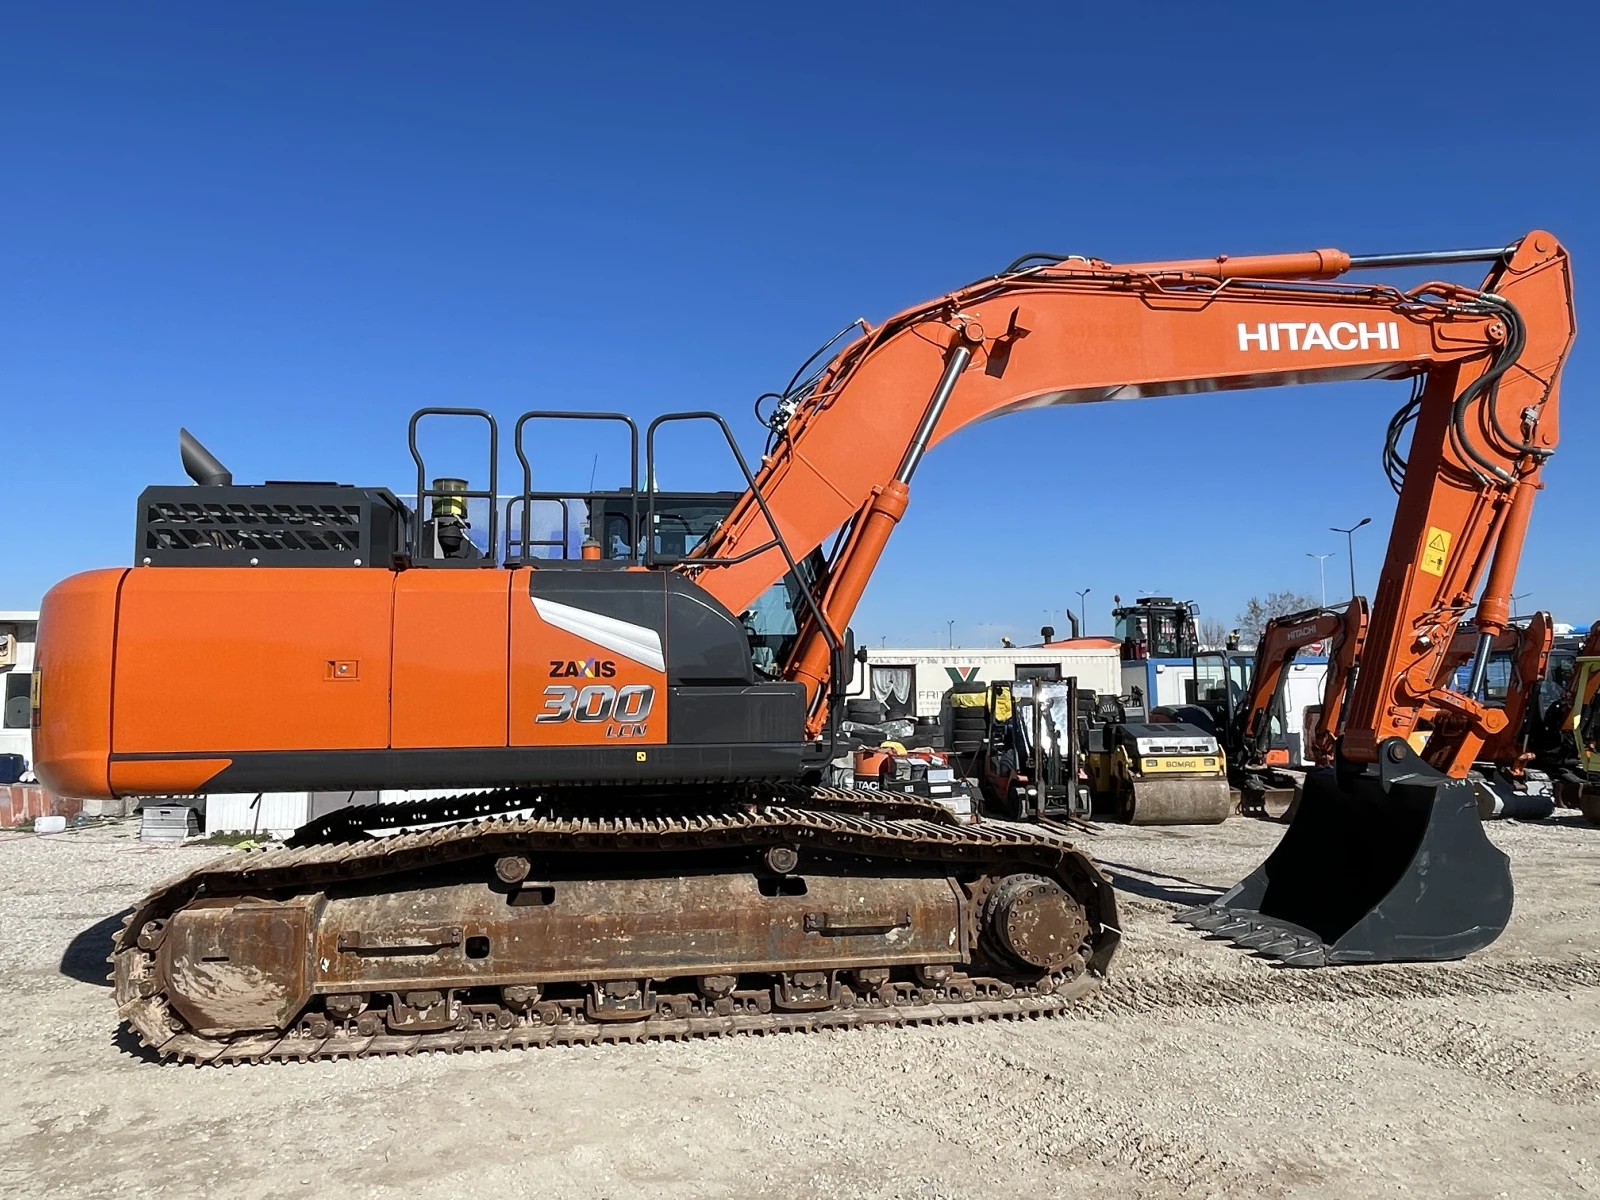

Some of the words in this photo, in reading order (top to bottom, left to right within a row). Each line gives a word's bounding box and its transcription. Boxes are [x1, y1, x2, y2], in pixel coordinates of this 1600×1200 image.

[1237, 321, 1400, 351] HITACHI
[1287, 624, 1317, 640] HITACHI
[549, 657, 616, 678] ZAXIS
[534, 684, 656, 723] 300
[605, 723, 648, 738] LCN
[1165, 760, 1197, 769] BOMAG
